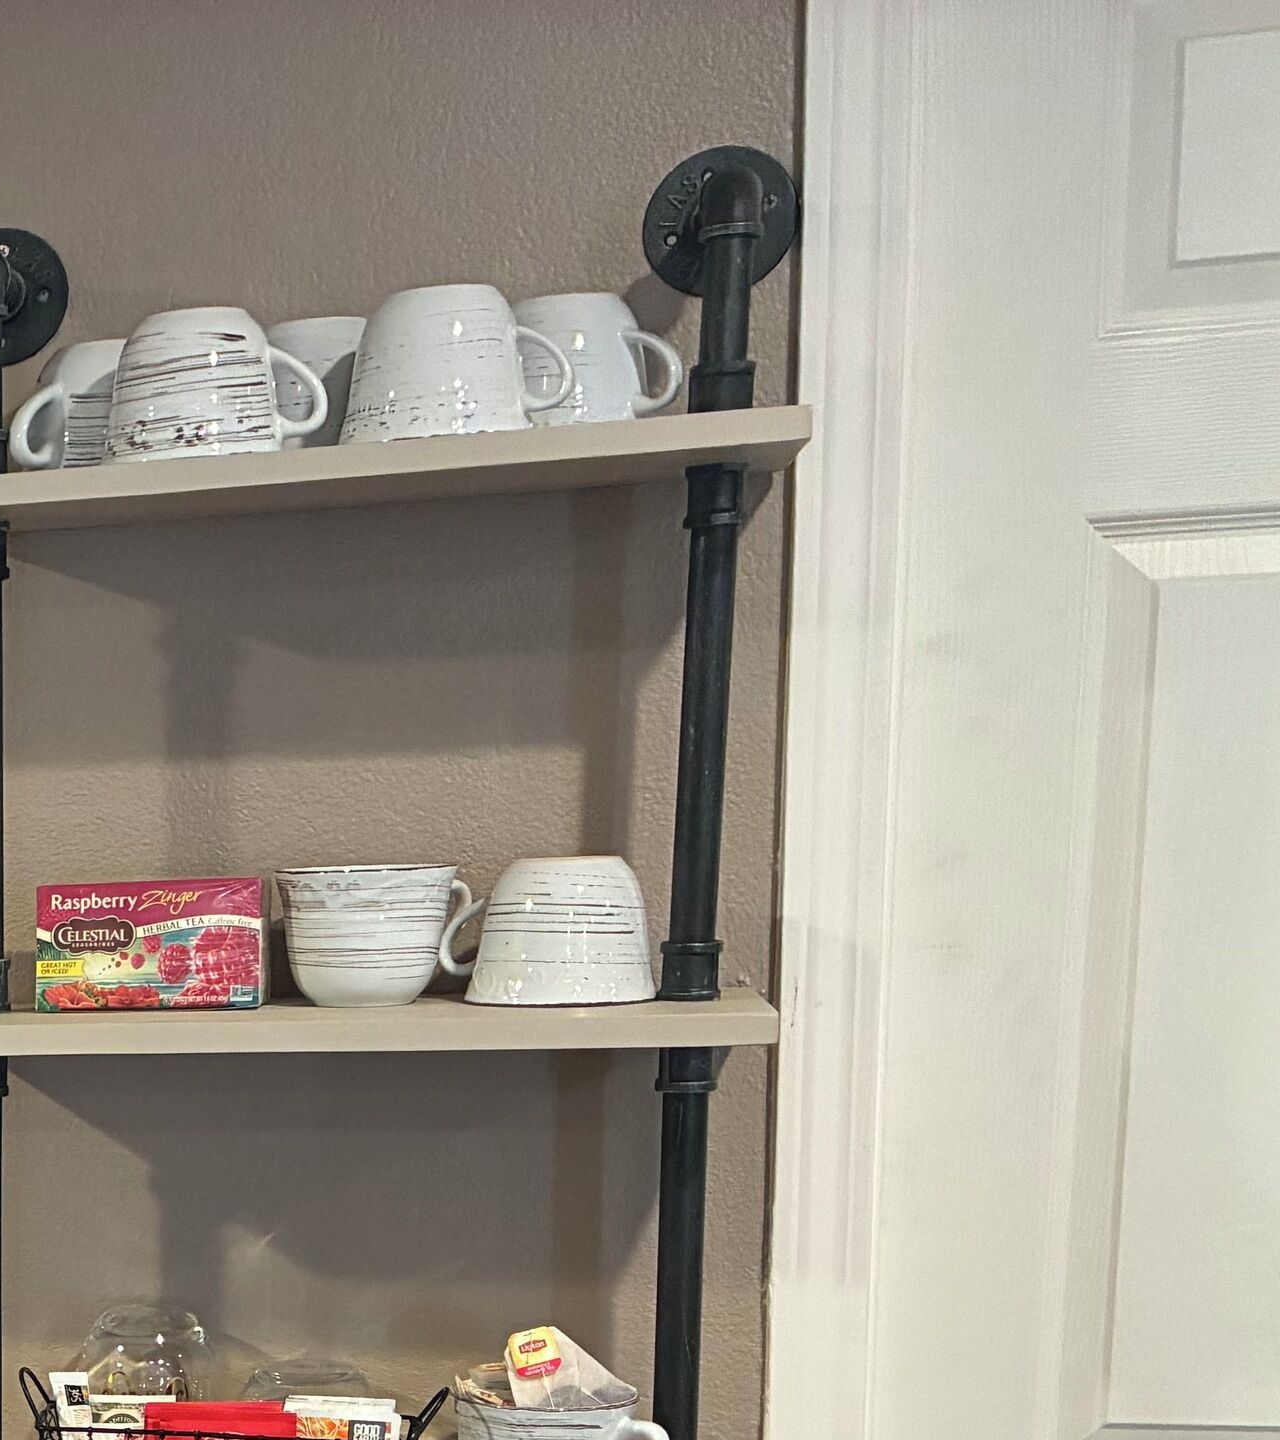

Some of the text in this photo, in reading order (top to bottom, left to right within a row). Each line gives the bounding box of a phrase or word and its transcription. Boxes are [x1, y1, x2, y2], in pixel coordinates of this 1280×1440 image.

[50, 889, 203, 915] Raspberry Zinger
[57, 926, 129, 945] CELESTIAL
[142, 920, 182, 936] HERBAL
[185, 917, 205, 929] TEA
[62, 961, 77, 969] HOT
[353, 1423, 381, 1436] GOOD
